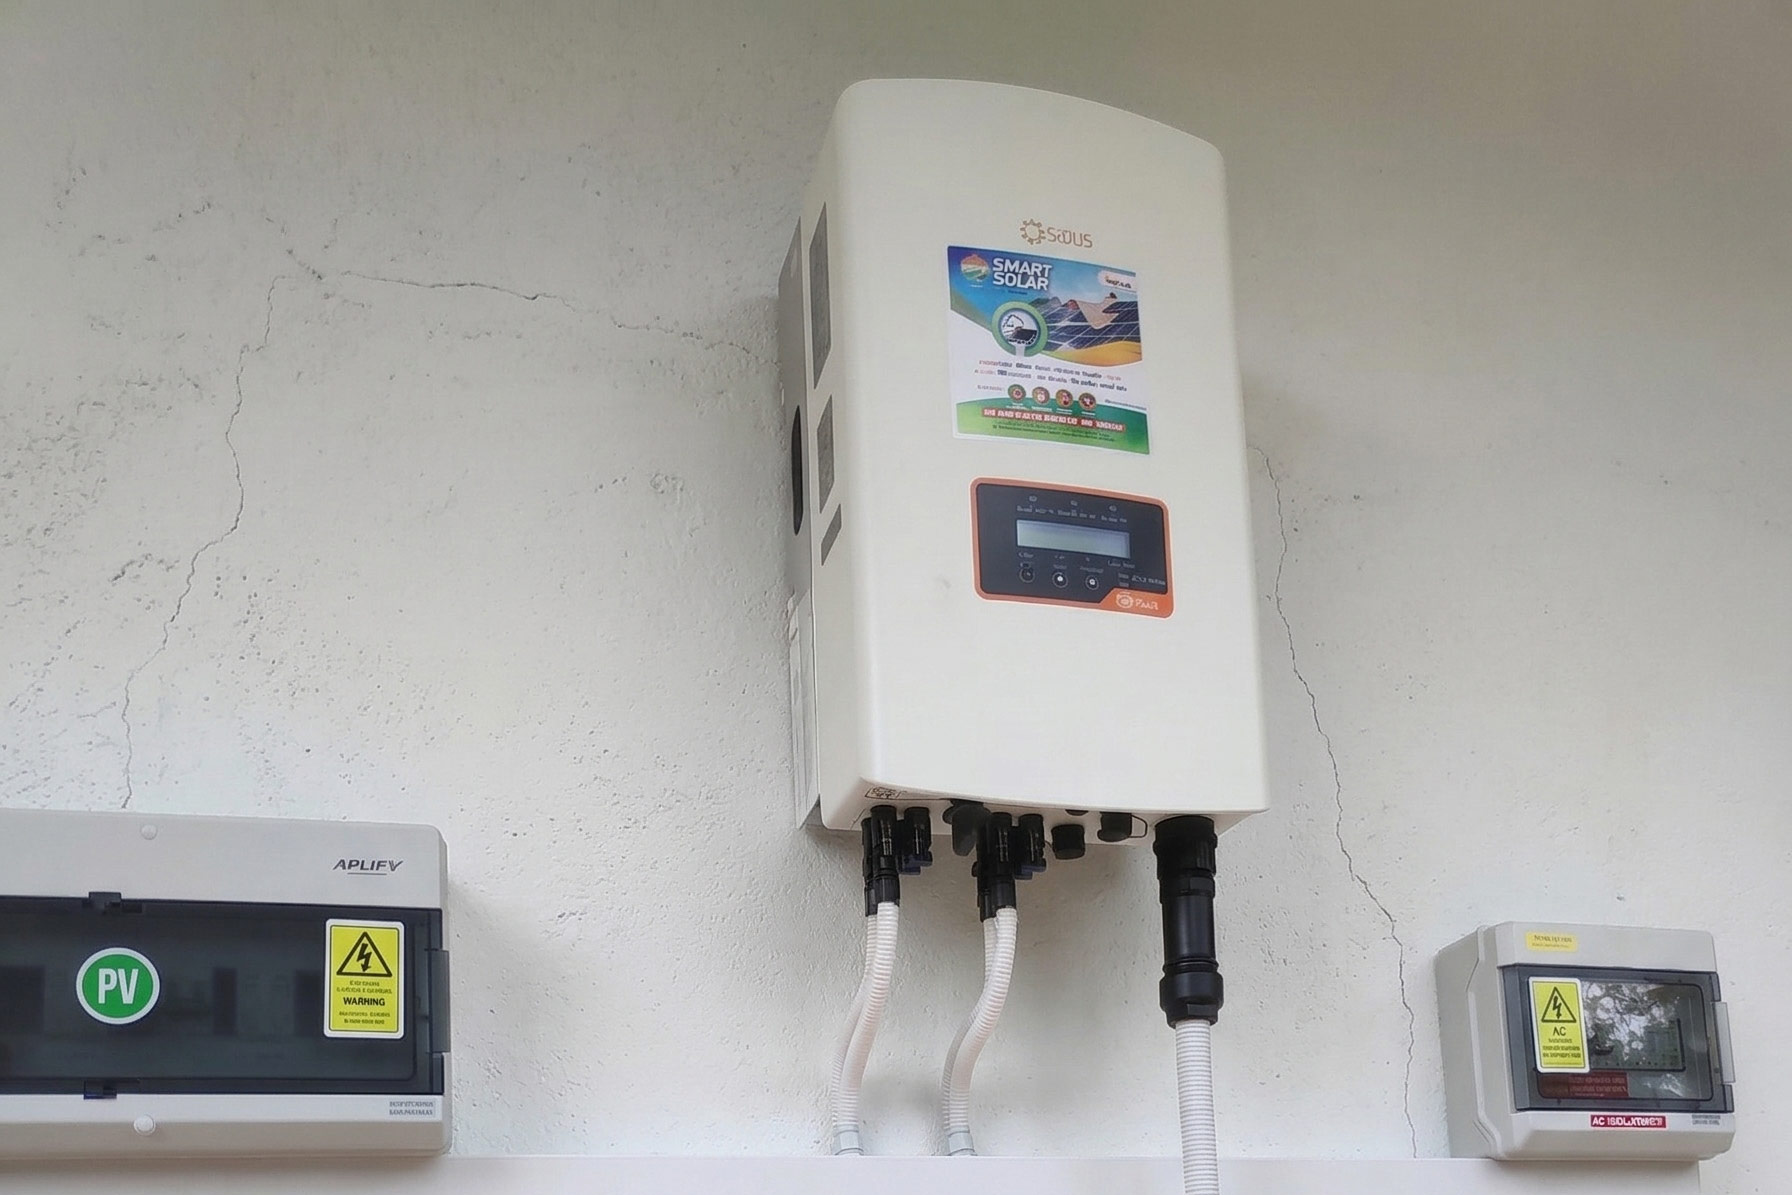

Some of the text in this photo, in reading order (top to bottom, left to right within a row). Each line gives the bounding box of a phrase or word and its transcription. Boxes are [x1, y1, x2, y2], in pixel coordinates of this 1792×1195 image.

[992, 257, 1052, 278] SMART
[992, 271, 1049, 291] SOLAR
[98, 968, 139, 1005] PV
[1552, 1026, 1567, 1036] AC
[1592, 1116, 1605, 1126] AC
